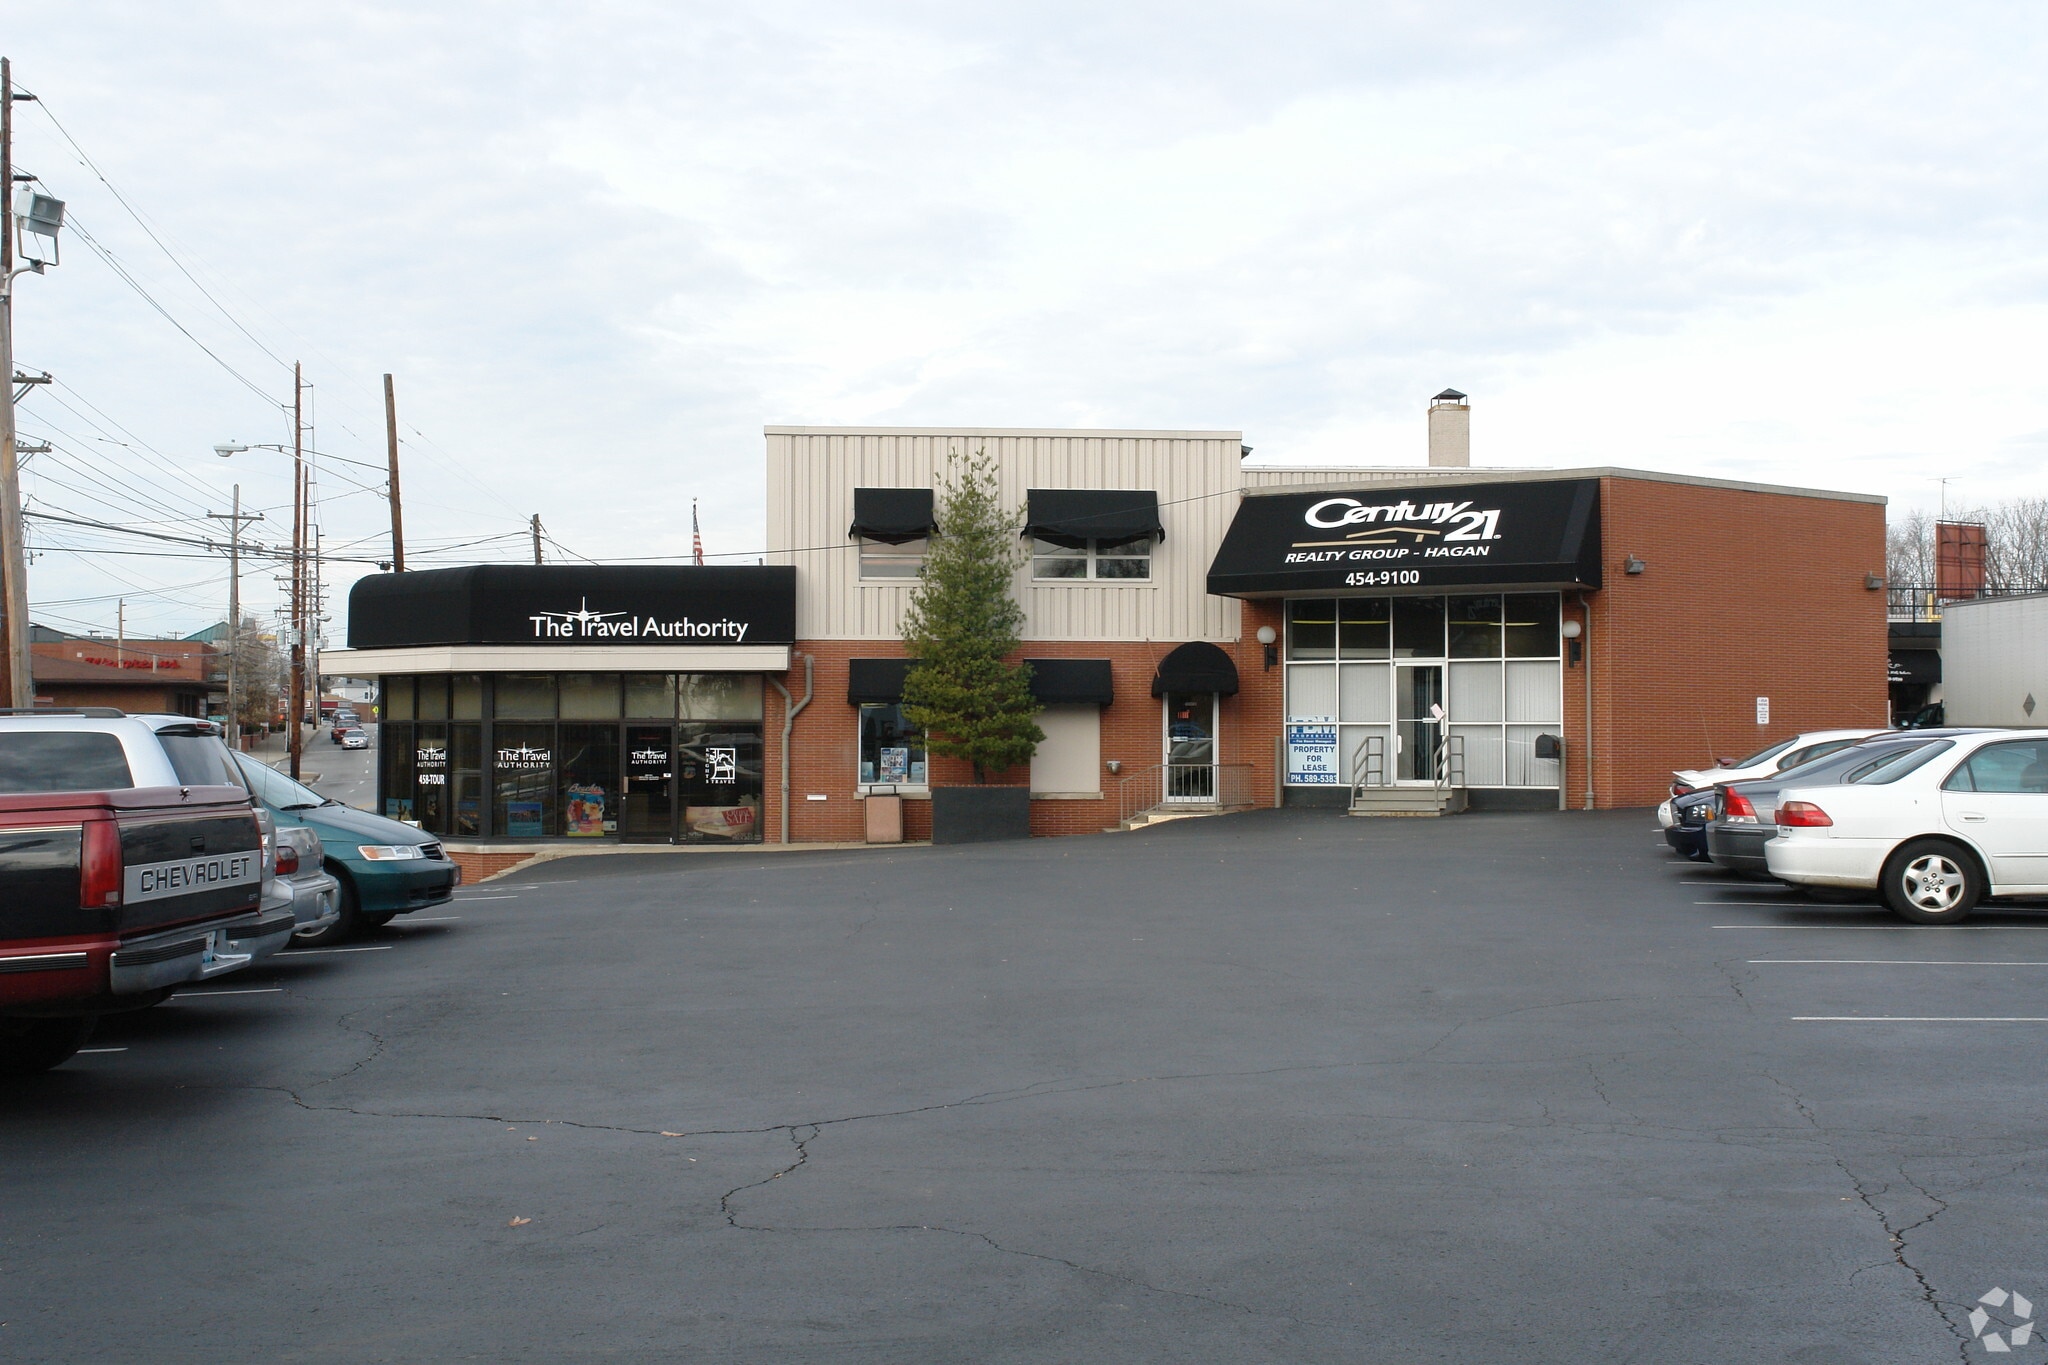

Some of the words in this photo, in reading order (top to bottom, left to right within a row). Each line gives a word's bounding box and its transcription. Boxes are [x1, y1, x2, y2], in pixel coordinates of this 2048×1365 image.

[1304, 497, 1473, 528] Century
[1443, 509, 1501, 542] 21
[1285, 550, 1346, 564] REALTY
[1349, 548, 1409, 560] GROUP
[1424, 545, 1490, 558] HAGAN
[1345, 569, 1420, 586] 454-9100
[529, 616, 573, 637] The
[577, 614, 638, 637] Travel
[642, 616, 749, 642] Authority
[416, 750, 429, 760] The
[430, 749, 446, 760] Travel
[1294, 745, 1335, 753] PROPERTY
[497, 750, 519, 761] The
[521, 749, 551, 761] Travel
[631, 751, 646, 760] The
[647, 751, 667, 760] Travel
[497, 761, 551, 769] AUTHORITY
[418, 774, 445, 785] 458-TOUR
[1290, 774, 1303, 783] PH.
[726, 814, 751, 824] SALE
[141, 856, 250, 893] CHEVROLET
